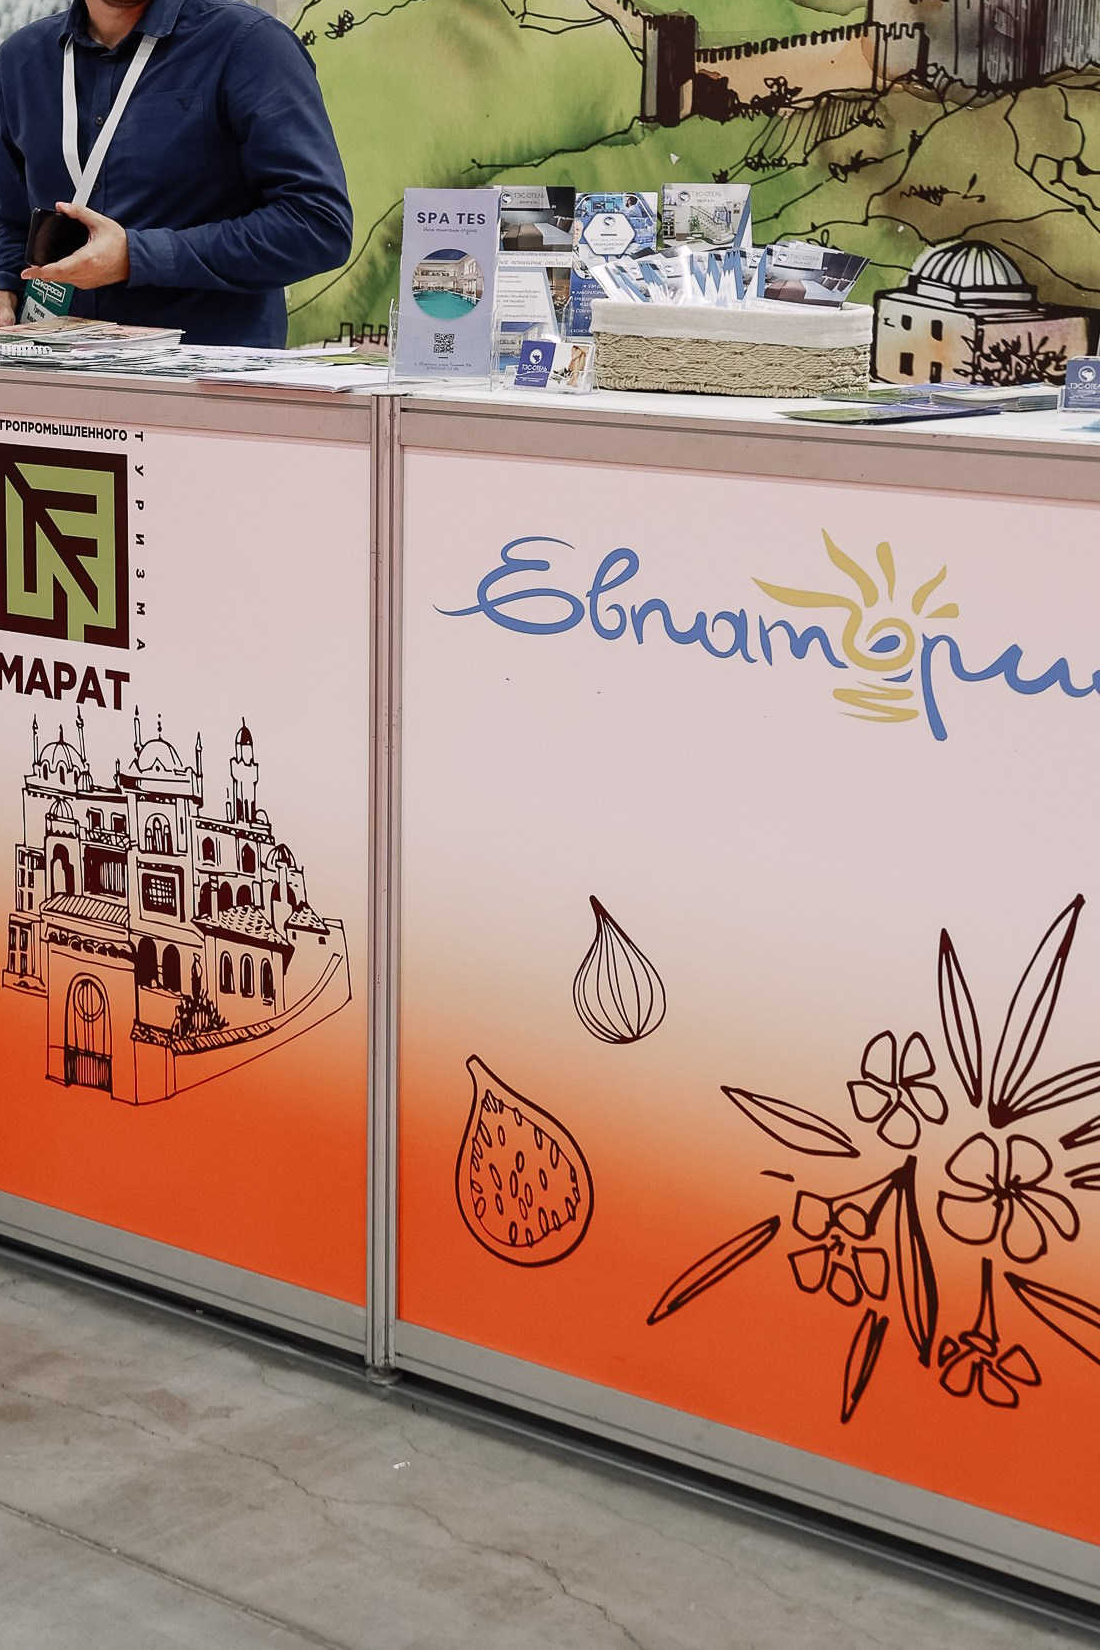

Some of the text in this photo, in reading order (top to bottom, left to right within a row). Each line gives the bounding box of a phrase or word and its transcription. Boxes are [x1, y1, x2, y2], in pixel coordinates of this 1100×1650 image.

[417, 212, 486, 225] SPA TES
[134, 431, 146, 651] ТУРИЗМА
[433, 530, 1100, 742] Евпатори
